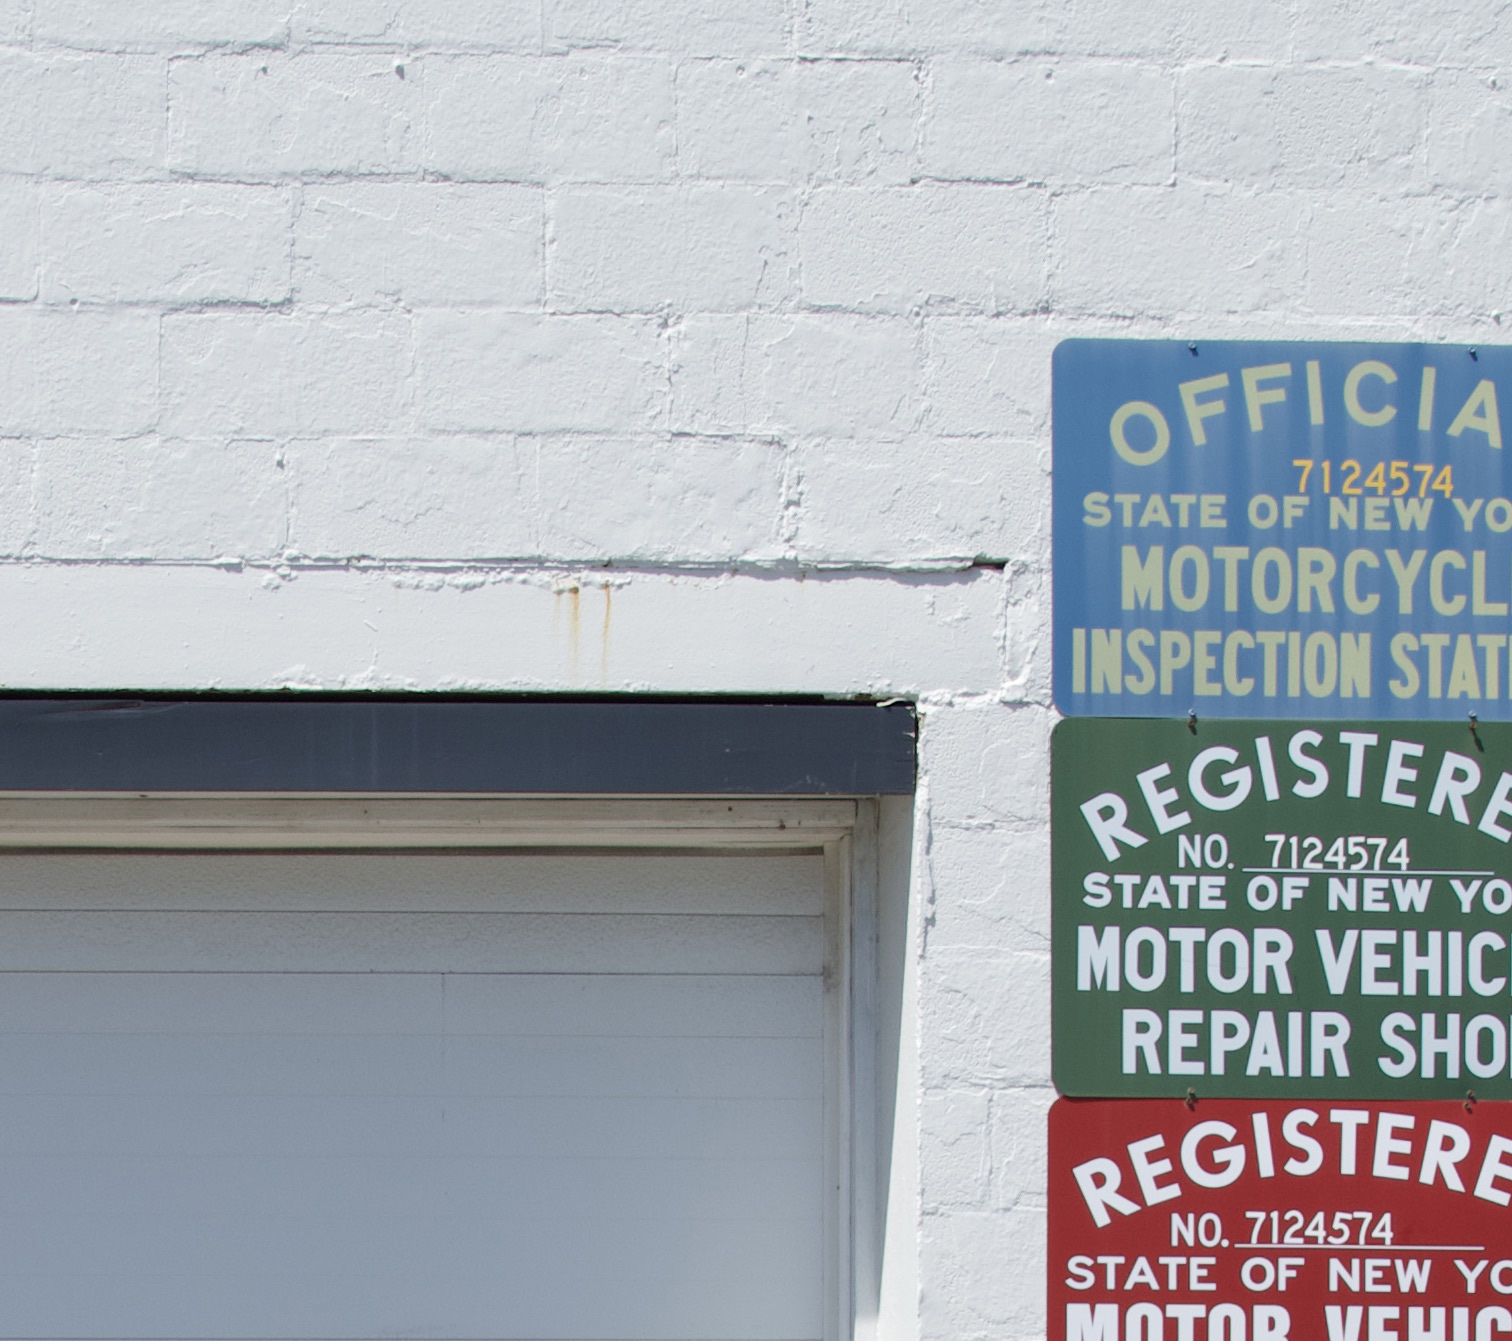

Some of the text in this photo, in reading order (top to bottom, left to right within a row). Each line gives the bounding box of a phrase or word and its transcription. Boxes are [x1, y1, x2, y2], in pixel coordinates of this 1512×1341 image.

[1292, 459, 1454, 499] 7124574
[1082, 491, 1227, 528] STATE
[1248, 495, 1310, 530] OF
[1329, 496, 1433, 532] NEW
[1072, 627, 1372, 699] INSPECTION
[1177, 833, 1410, 871] NO. 7124574
[1082, 872, 1226, 909] STATE
[1246, 876, 1310, 911] OF
[1328, 878, 1433, 913] NEW
[1077, 925, 1293, 995] MOTOR
[1122, 1008, 1351, 1078] REPAIR
[1171, 1210, 1394, 1248] NO. 7124574
[1064, 1256, 1217, 1291] STATE
[1240, 1257, 1306, 1293] OF
[1328, 1258, 1432, 1294] NEW
